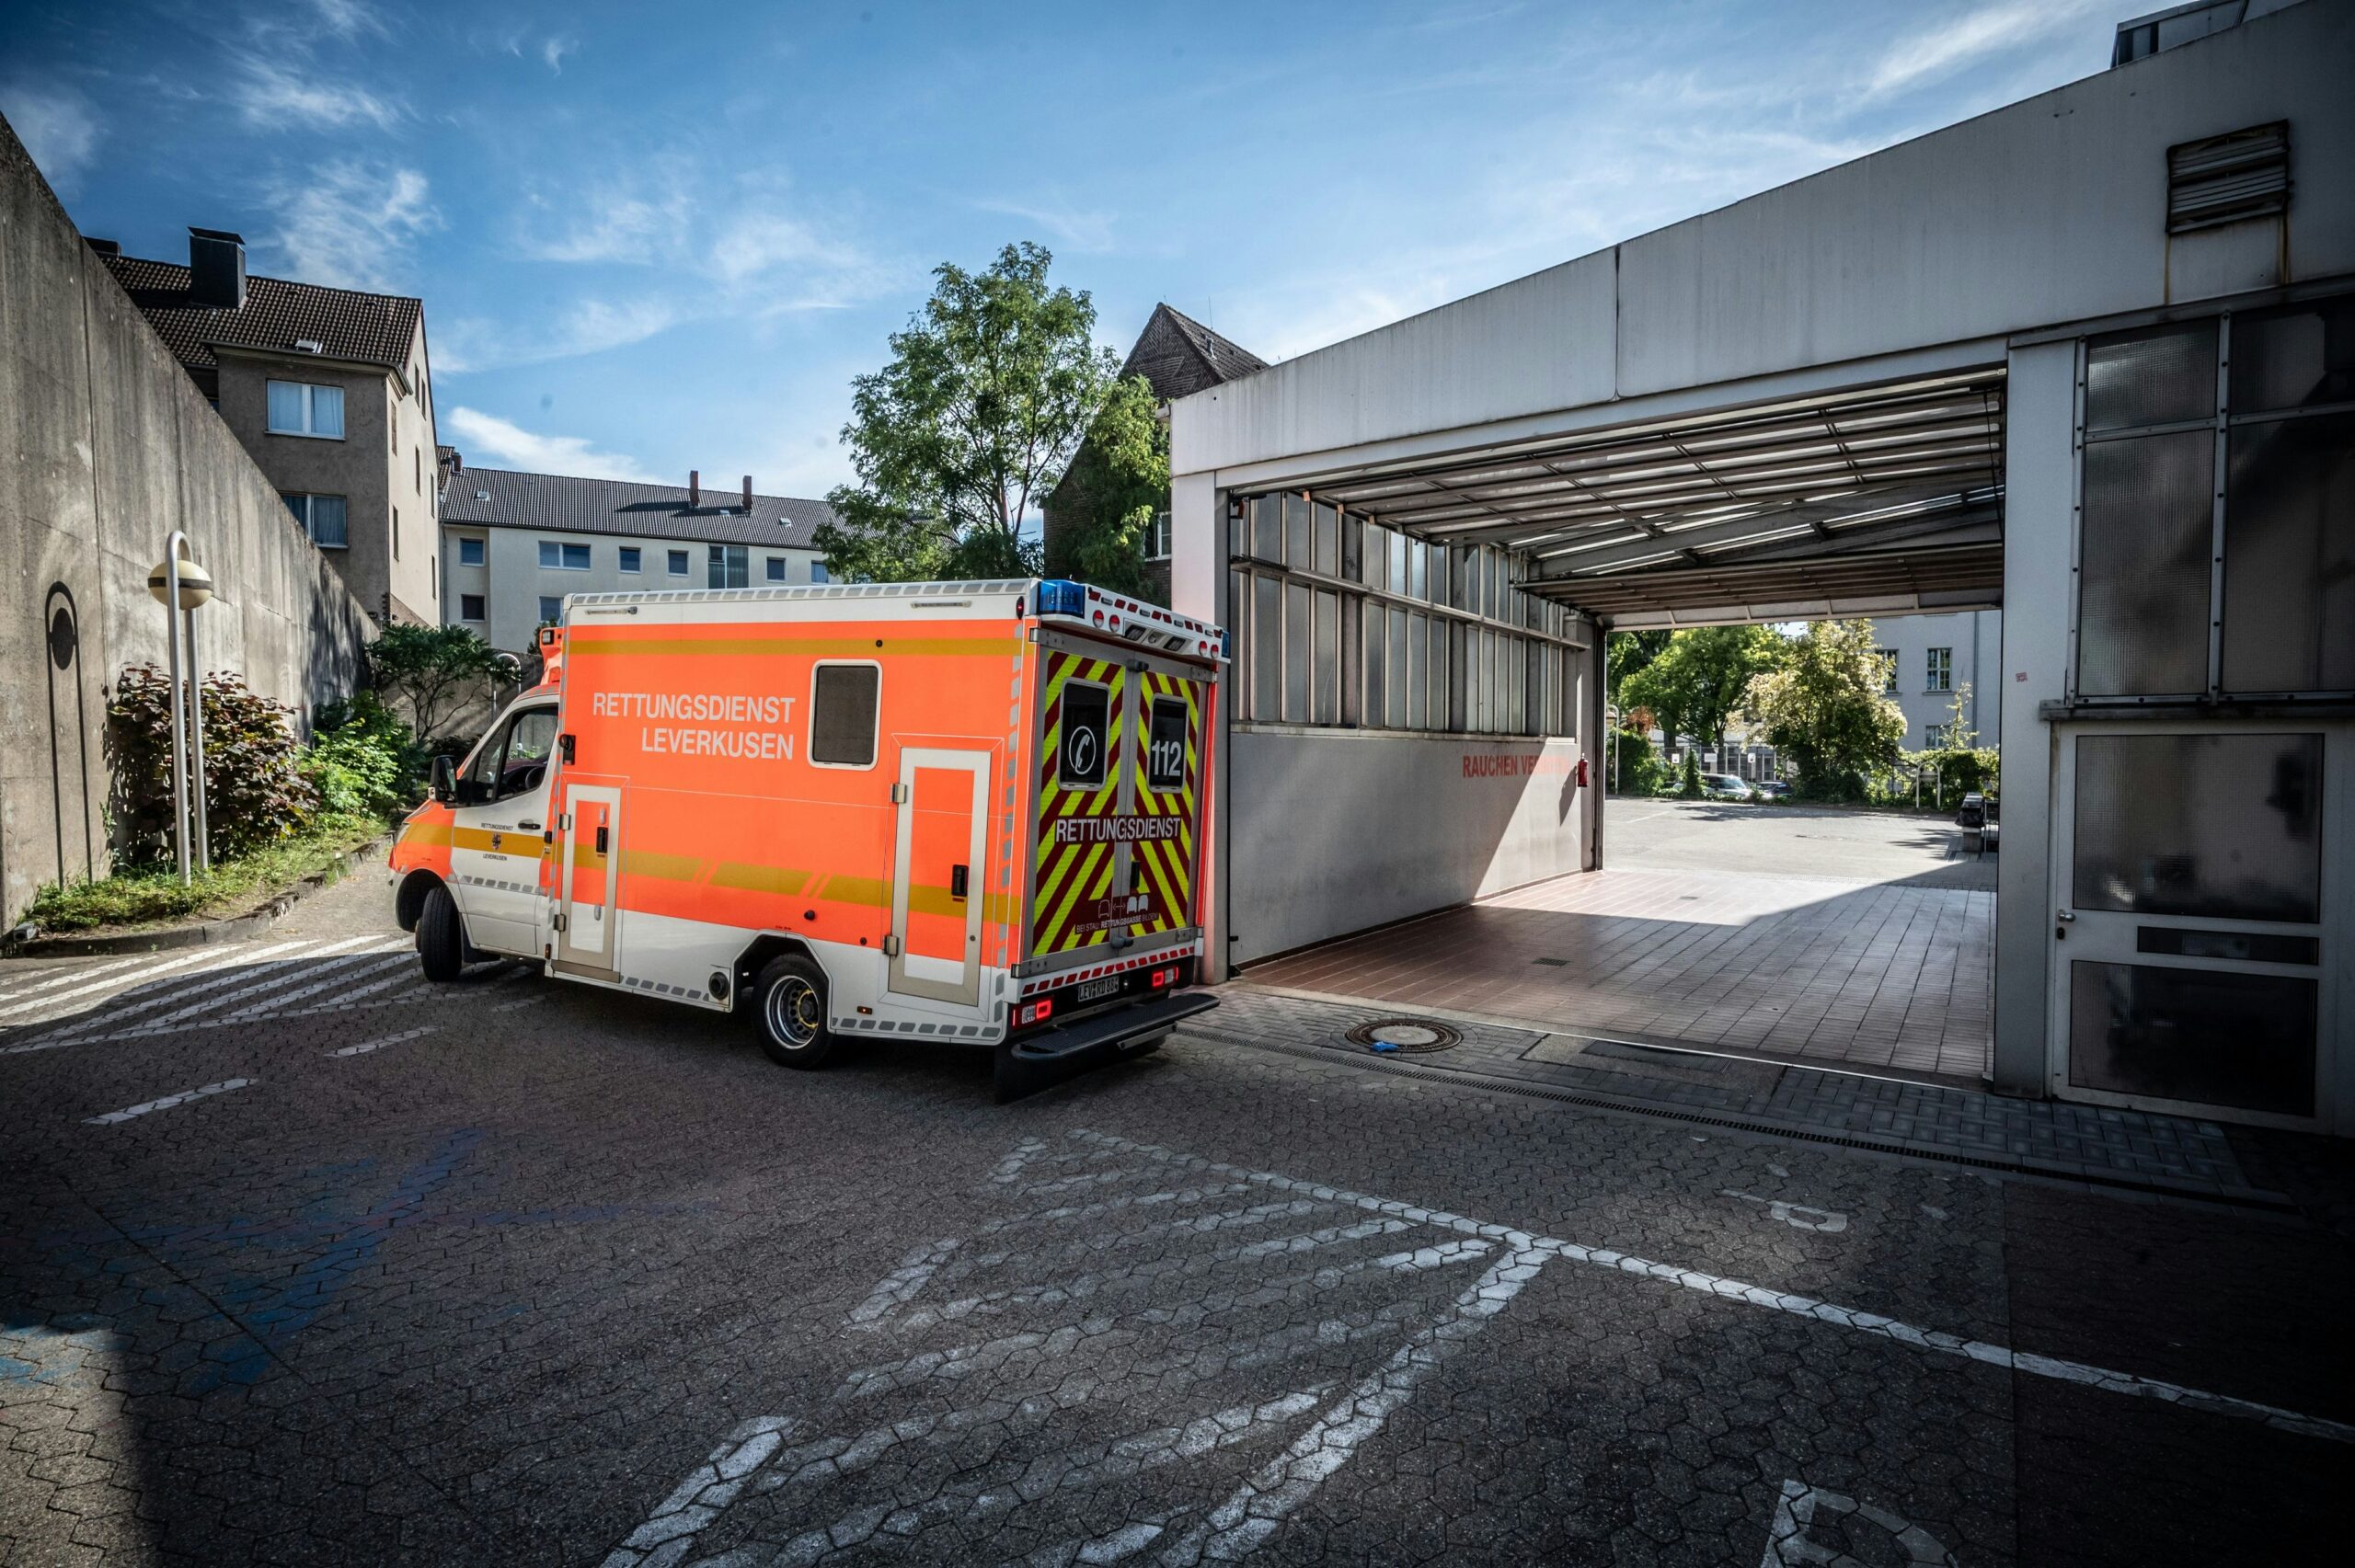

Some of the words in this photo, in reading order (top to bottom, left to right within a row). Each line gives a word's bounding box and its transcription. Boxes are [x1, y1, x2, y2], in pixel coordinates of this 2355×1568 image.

[592, 692, 796, 724] RETTUNGSDIENST
[641, 727, 794, 760] LEVERKUSEN
[1151, 739, 1182, 776] 112
[1463, 755, 1517, 778] RAUCHEN
[1055, 817, 1180, 842] RETTUNGSDIENST
